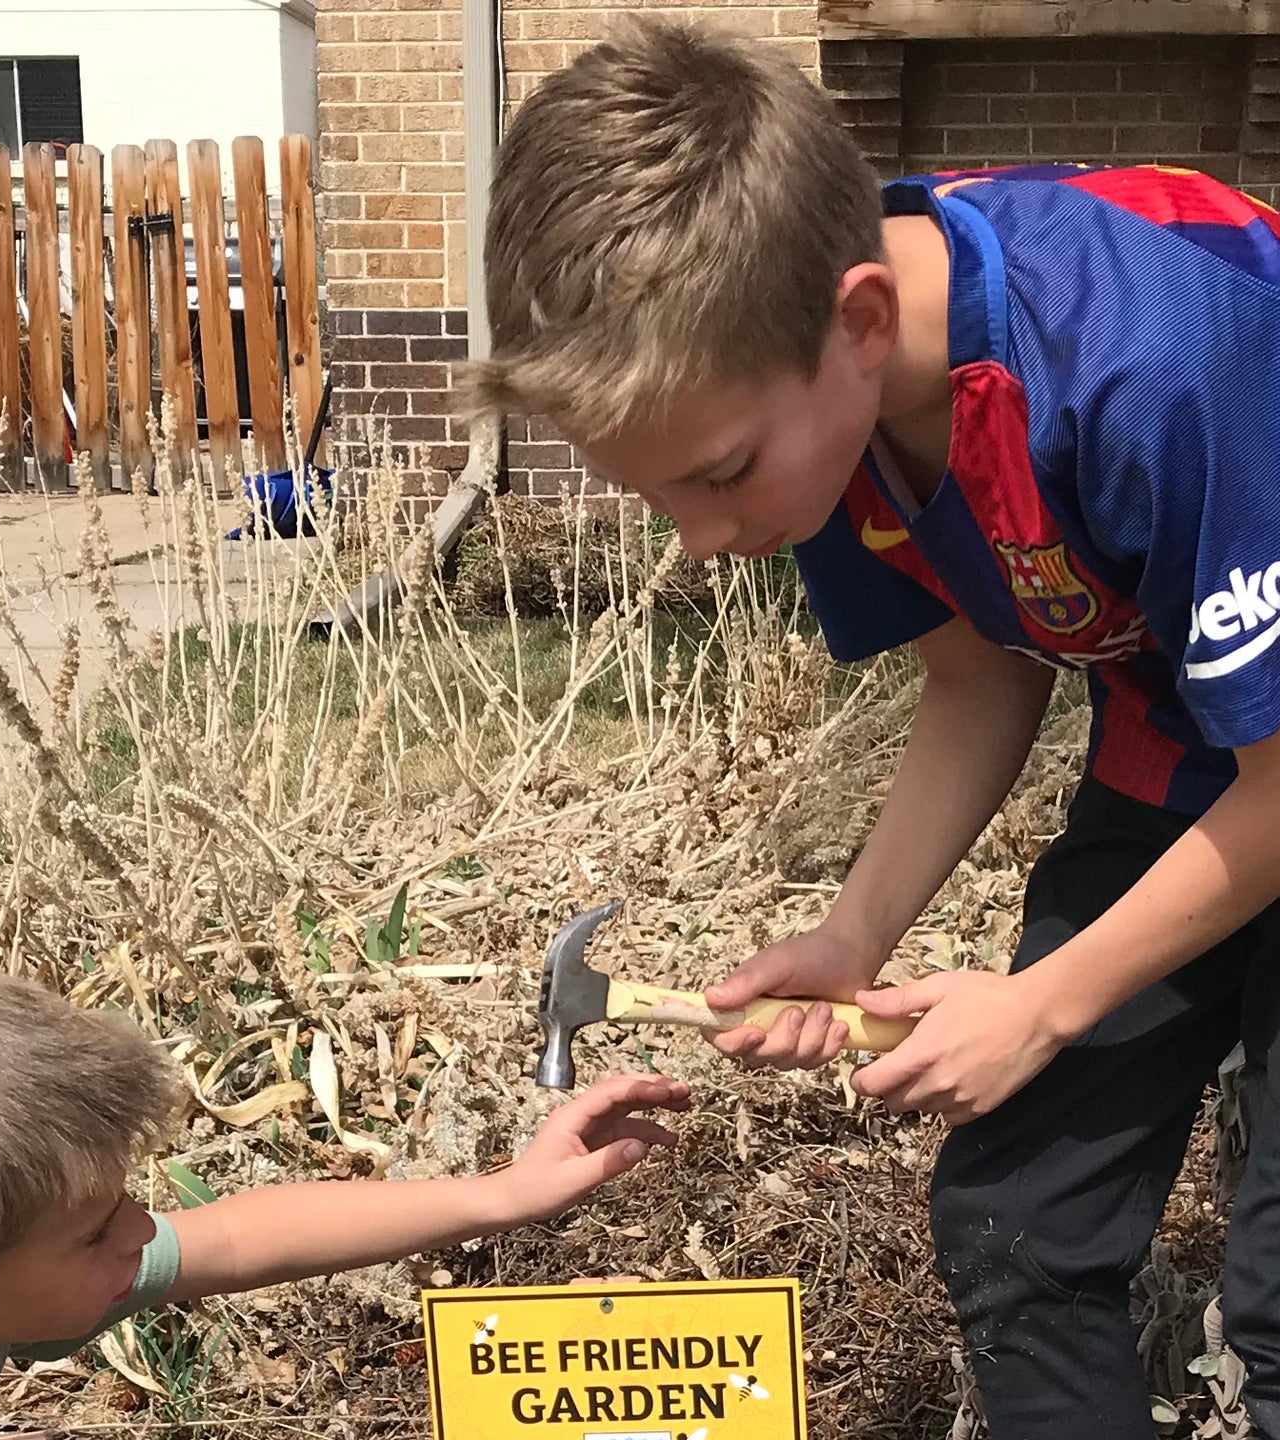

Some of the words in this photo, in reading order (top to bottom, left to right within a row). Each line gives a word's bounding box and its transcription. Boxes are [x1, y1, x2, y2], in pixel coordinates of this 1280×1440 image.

[470, 1342, 546, 1375] BEE
[558, 1335, 763, 1373] FRIENDLY
[511, 1383, 727, 1424] GARDEN
